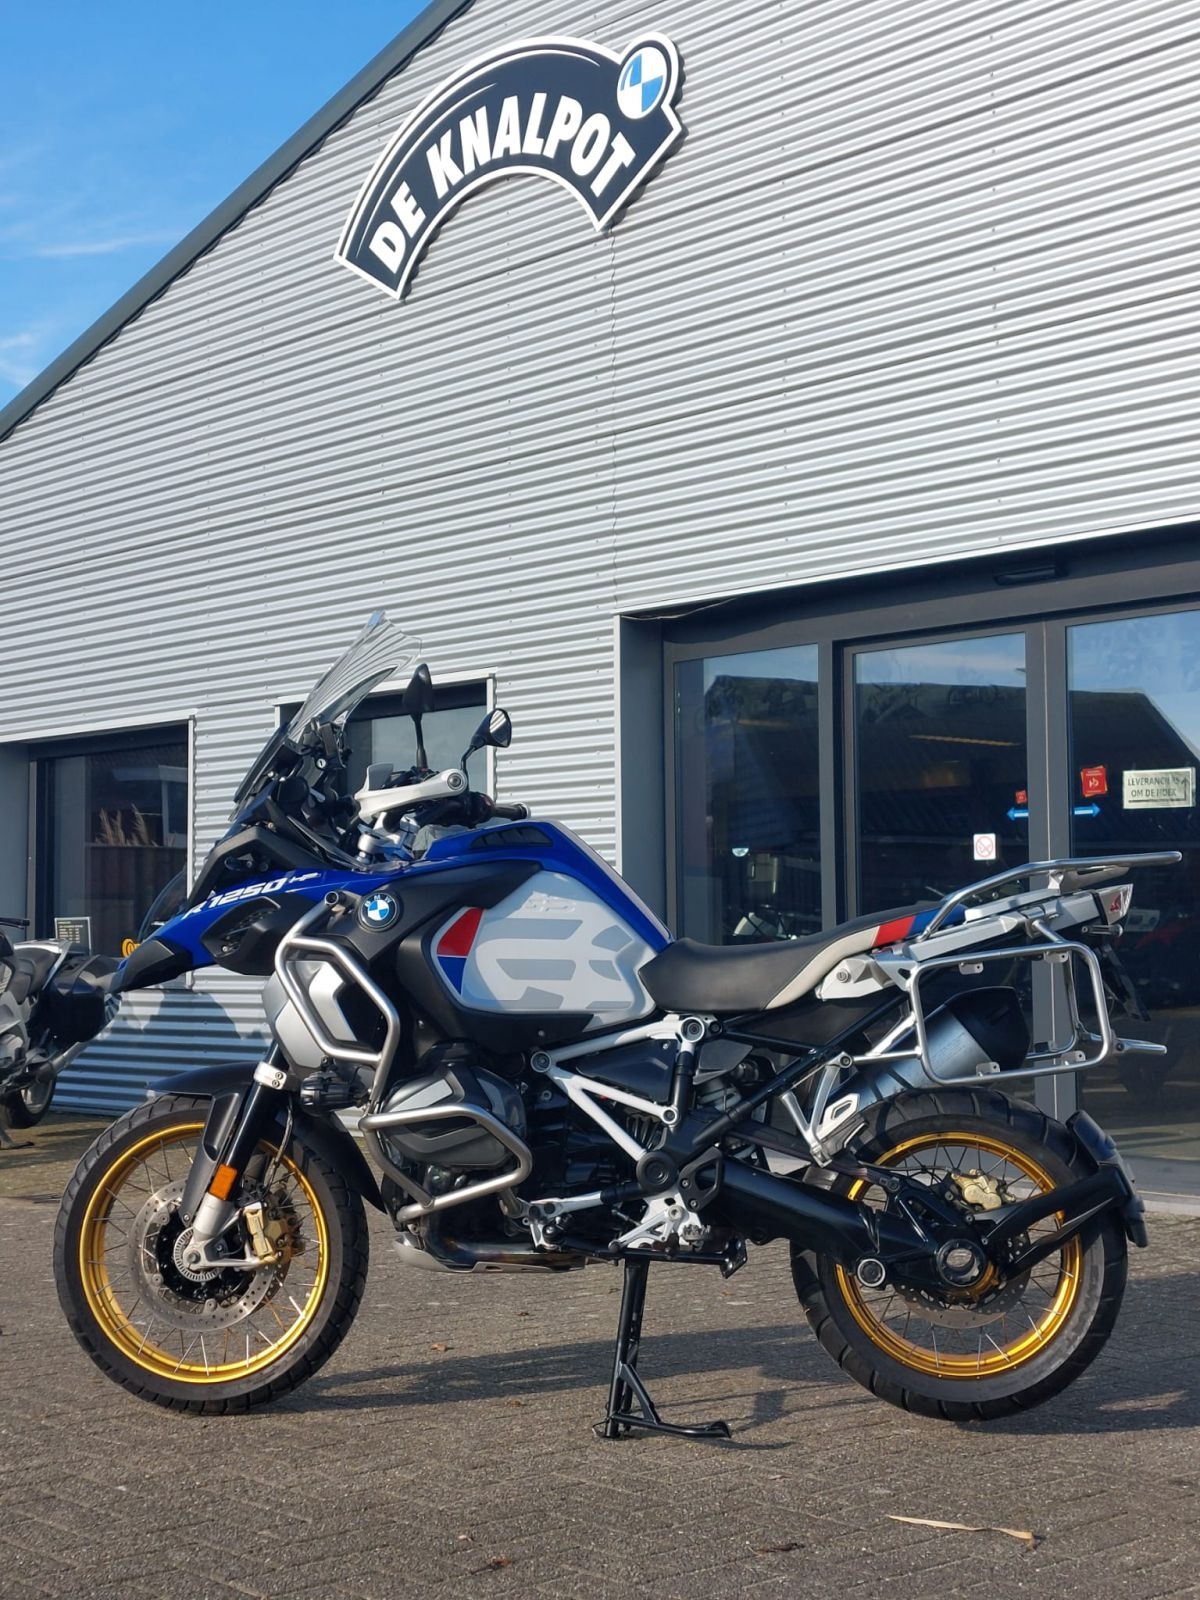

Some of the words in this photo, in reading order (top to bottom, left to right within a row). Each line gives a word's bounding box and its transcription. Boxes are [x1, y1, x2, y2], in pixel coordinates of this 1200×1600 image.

[369, 181, 426, 274] DE
[426, 92, 636, 199] KNALPOT
[1131, 789, 1143, 797] OM
[1146, 789, 1155, 797] DE
[208, 877, 288, 908] 1250
[364, 894, 393, 907] BMW
